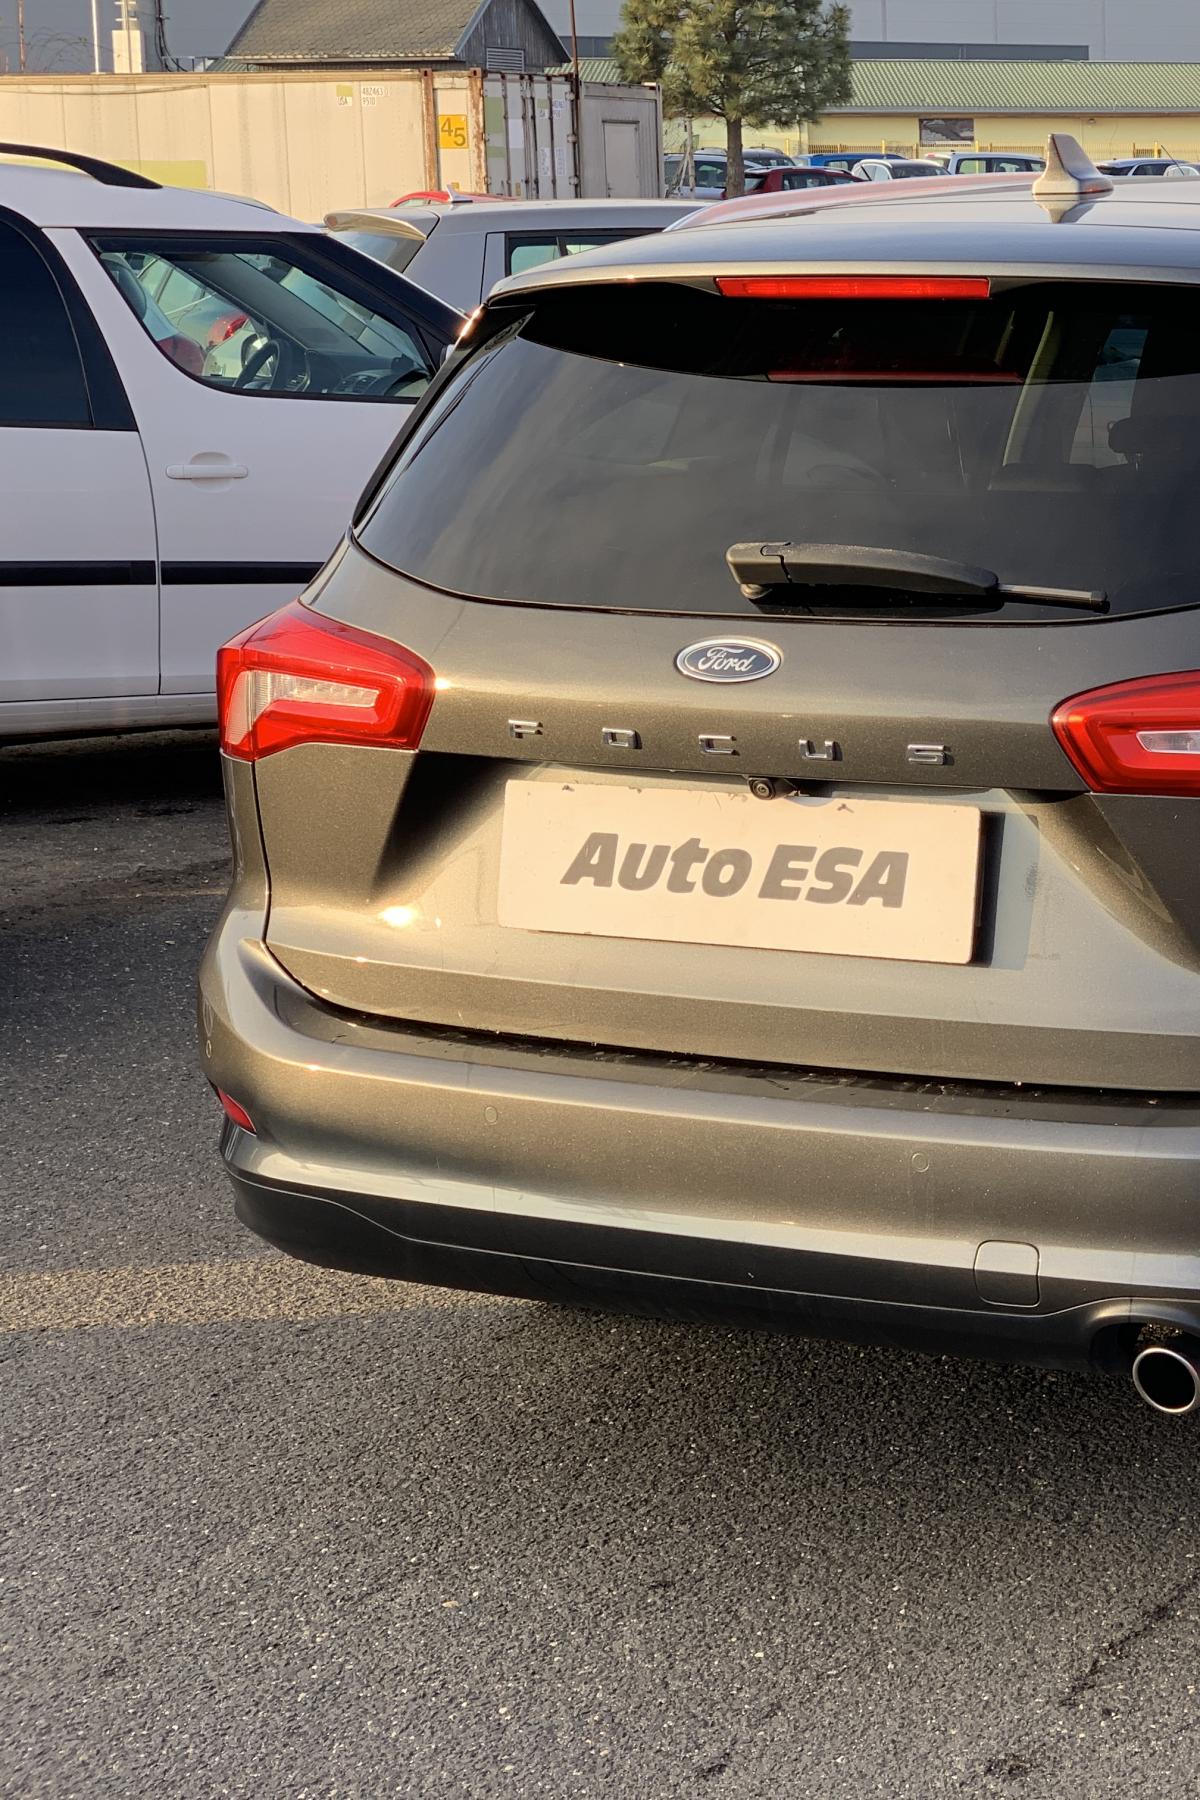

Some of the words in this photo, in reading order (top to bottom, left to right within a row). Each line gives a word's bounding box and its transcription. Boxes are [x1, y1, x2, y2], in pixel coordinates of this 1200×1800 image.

[698, 646, 757, 672] Ford
[508, 718, 947, 766] FOCUS
[559, 831, 753, 898] Auto
[757, 843, 910, 909] ESA
